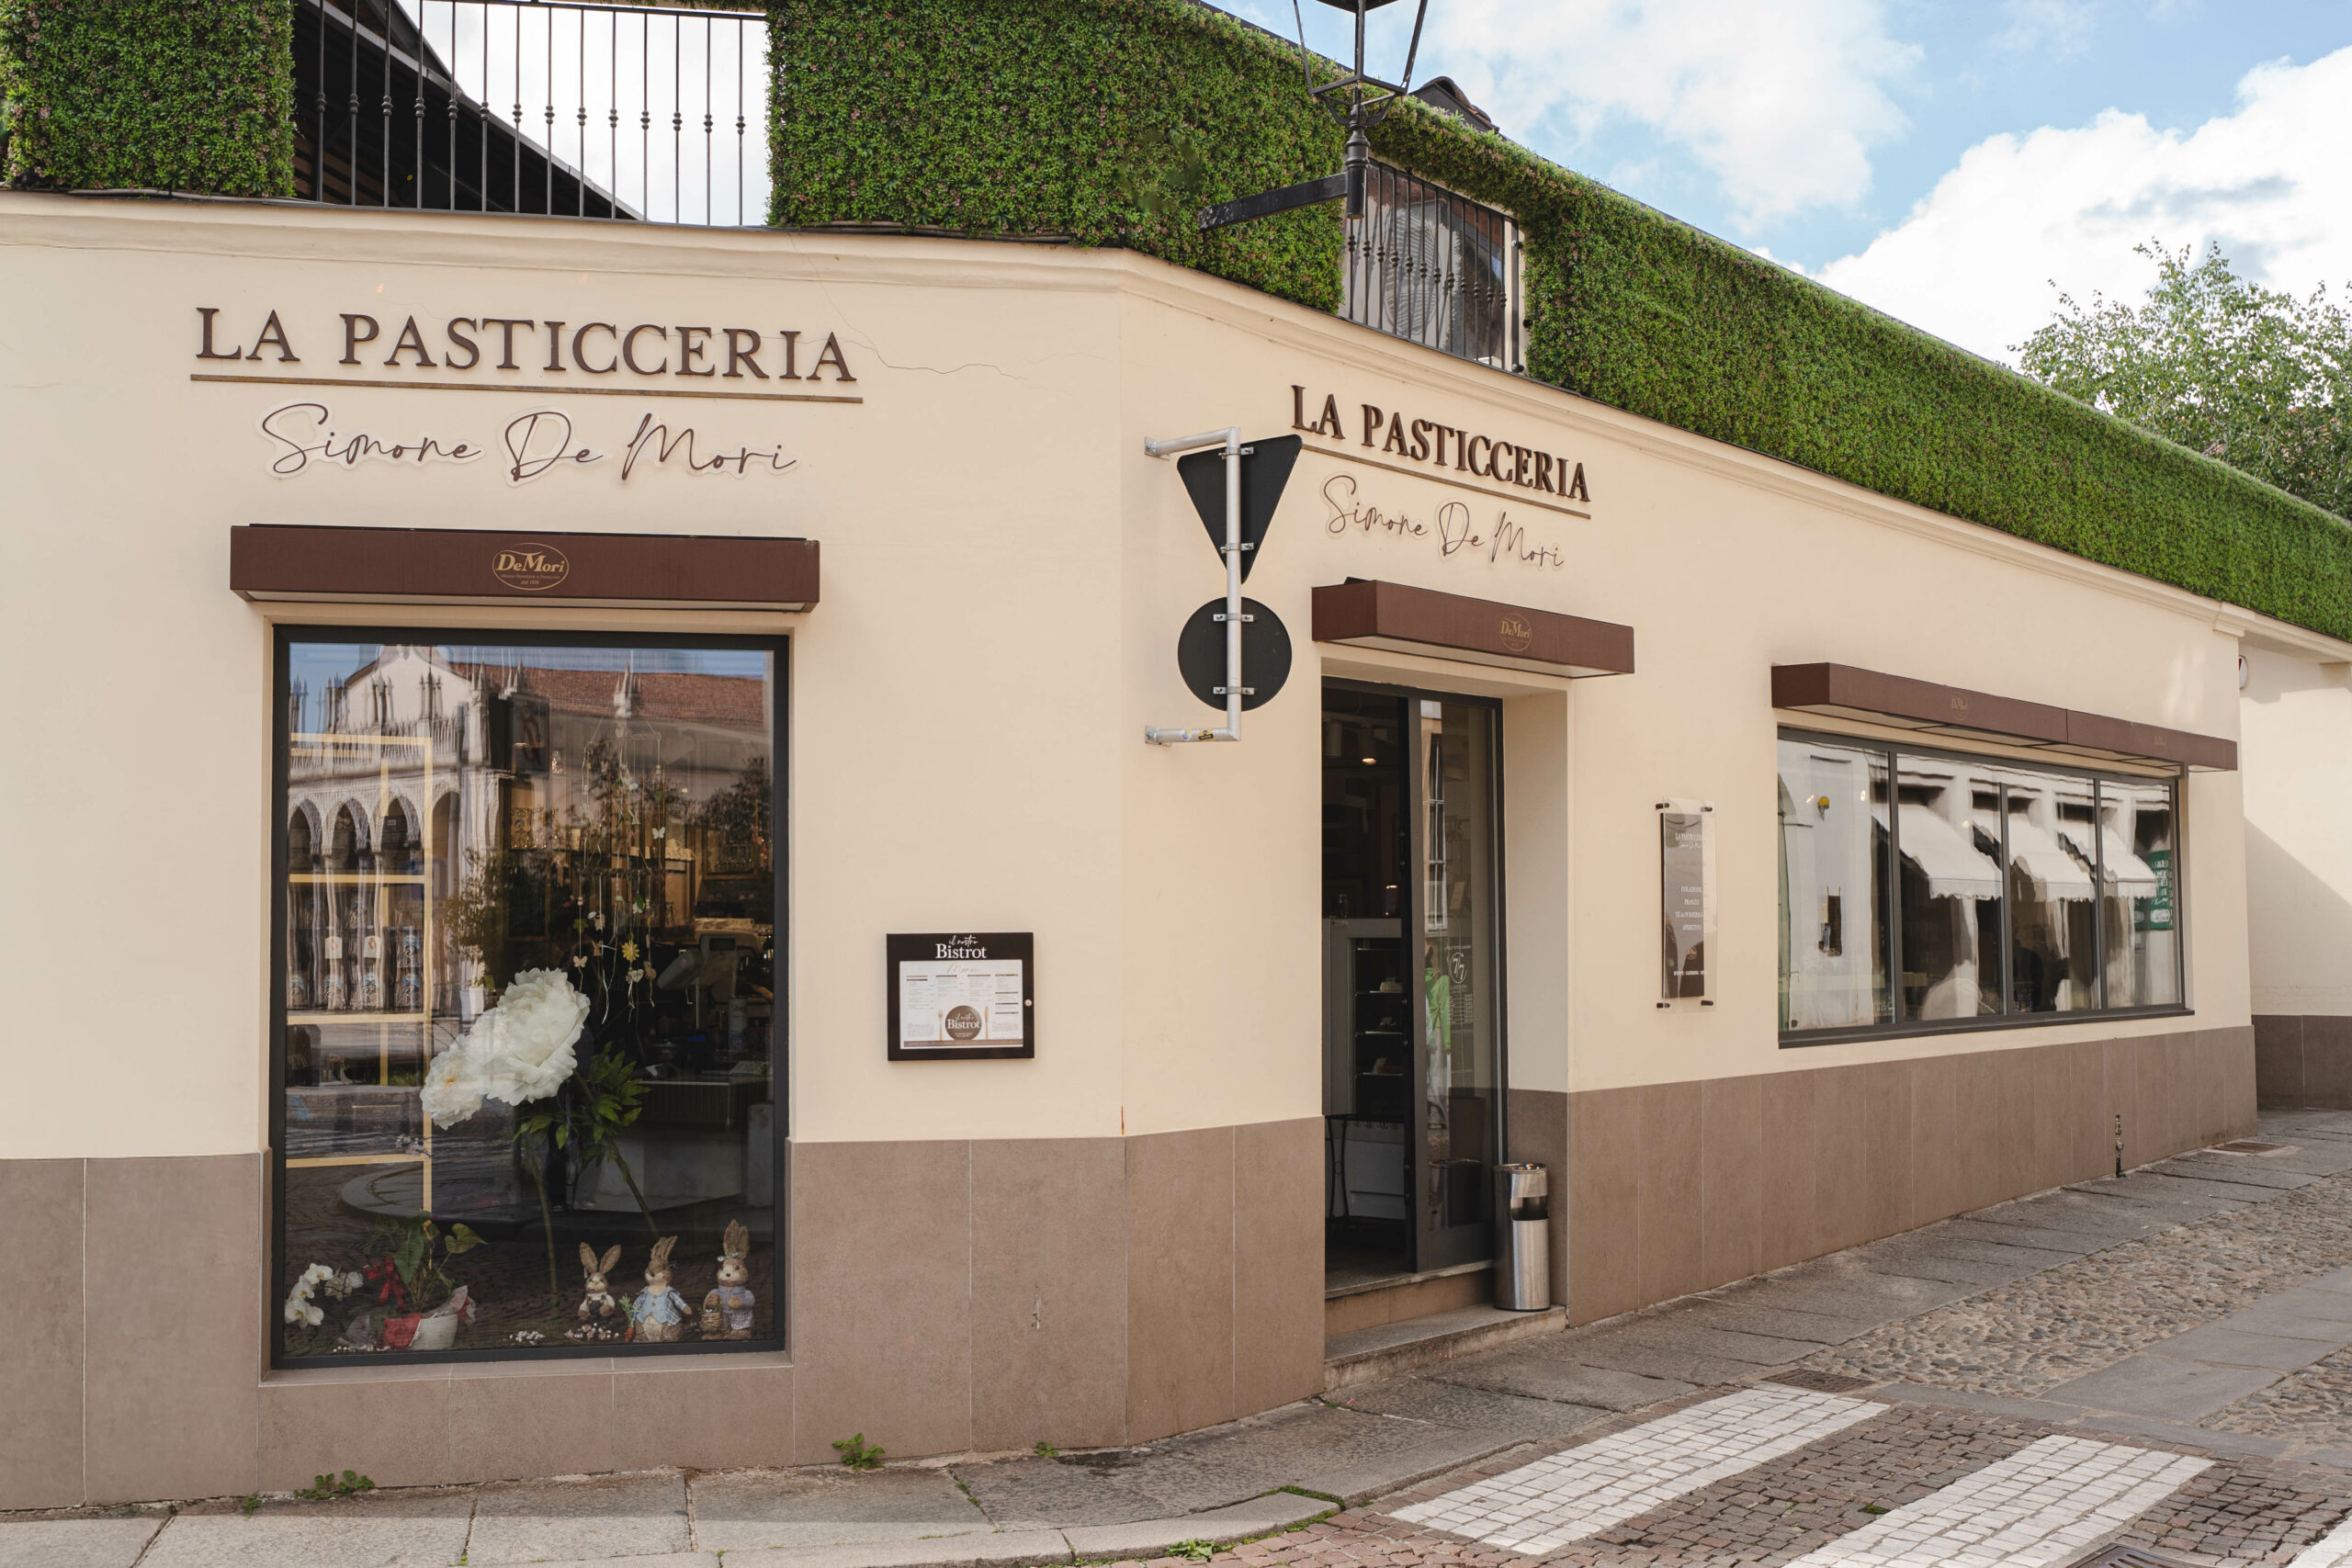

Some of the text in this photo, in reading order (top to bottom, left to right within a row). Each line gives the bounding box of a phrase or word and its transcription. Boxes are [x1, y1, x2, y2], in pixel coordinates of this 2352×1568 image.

[195, 307, 857, 383] LA PASTICCERIA
[262, 402, 797, 482] Simone De Mori
[1291, 384, 1591, 503] LA PASTICCERIA
[1323, 474, 1565, 568] Simone De Mori
[934, 942, 988, 959] Bistrot
[946, 1018, 981, 1030] Bistrot
